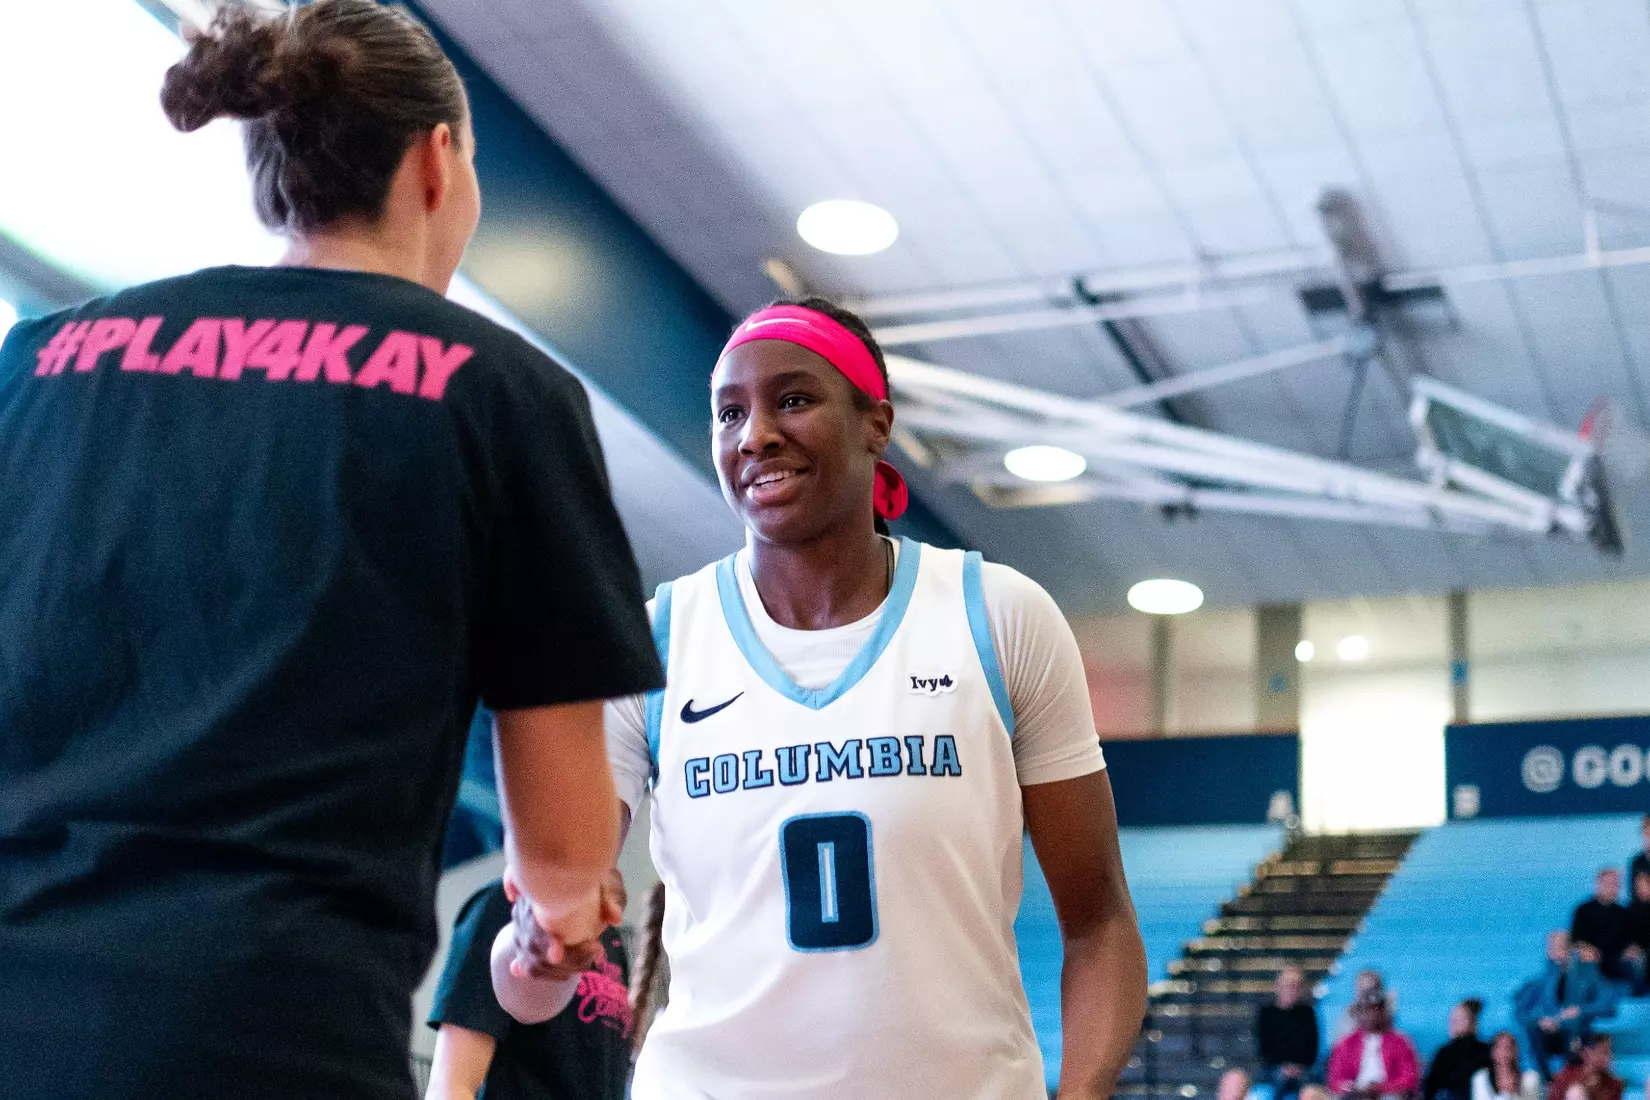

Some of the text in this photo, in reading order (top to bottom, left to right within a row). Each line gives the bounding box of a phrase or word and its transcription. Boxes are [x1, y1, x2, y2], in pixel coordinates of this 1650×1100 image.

[34, 316, 475, 400] #PLAY4KAY
[910, 676, 938, 692] Ivy
[684, 735, 962, 799] COLUMBIA
[778, 810, 880, 953] 0
